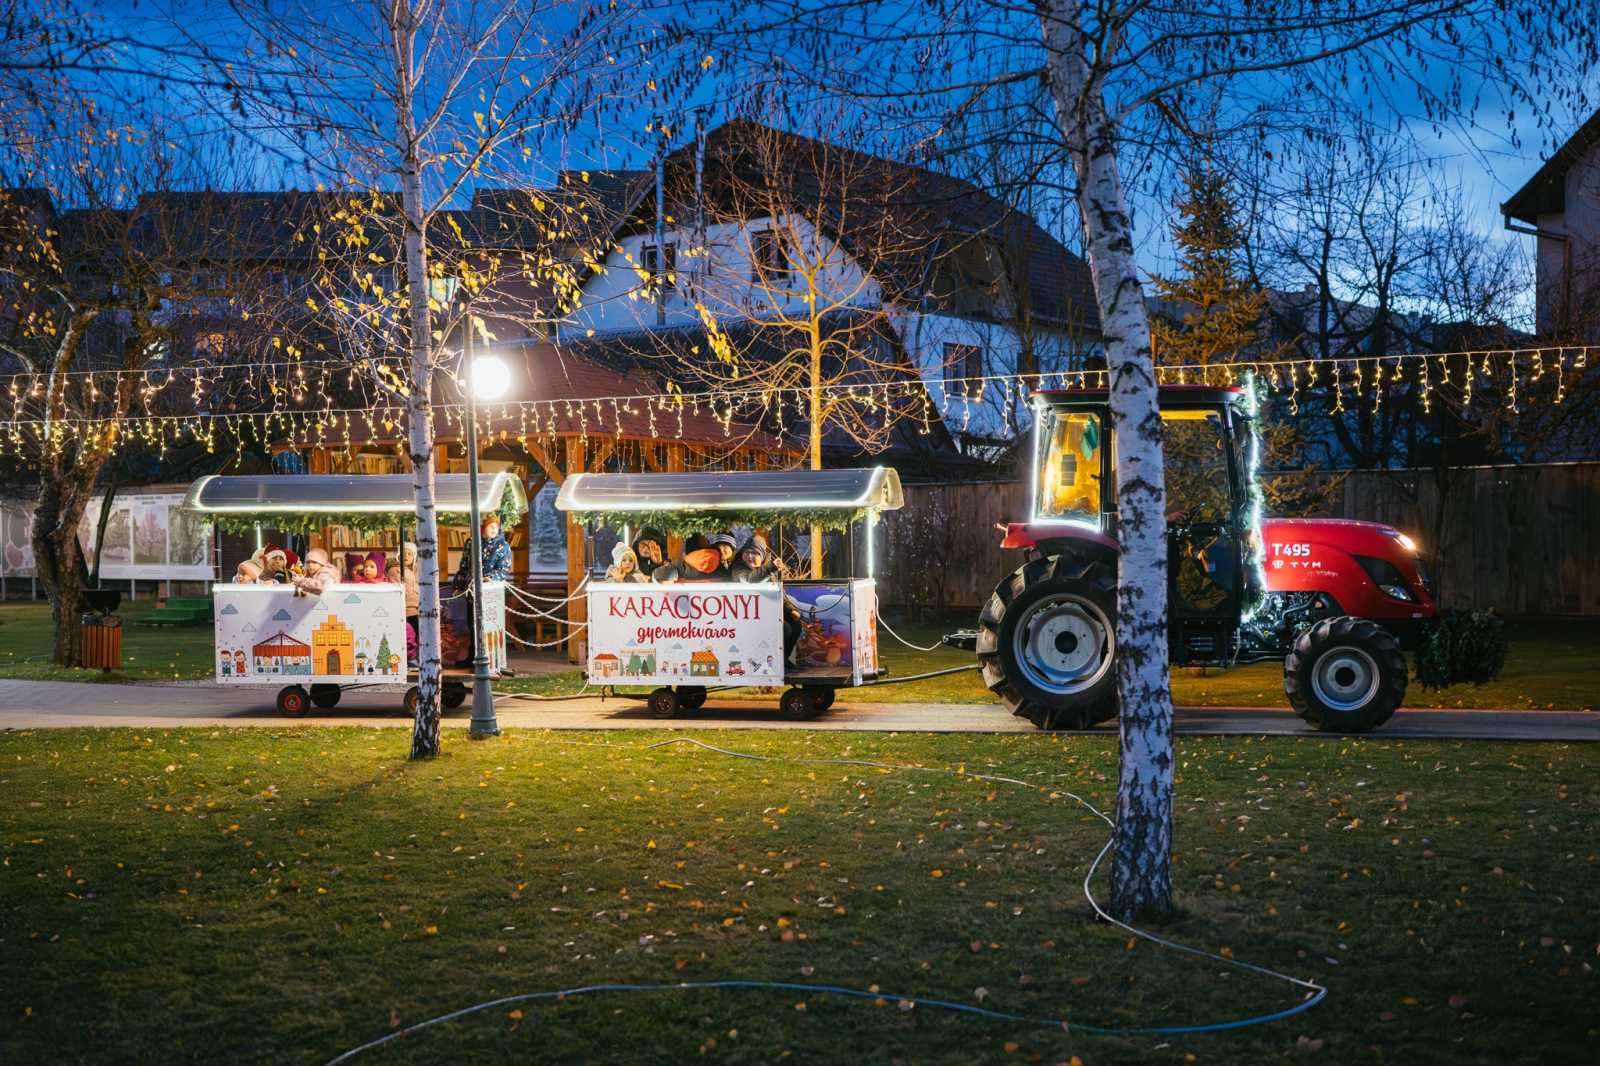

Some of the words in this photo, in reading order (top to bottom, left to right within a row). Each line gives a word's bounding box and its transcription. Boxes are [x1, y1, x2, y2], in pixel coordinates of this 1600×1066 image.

[1271, 543, 1311, 557] T495
[1290, 561, 1321, 569] TYM
[608, 592, 761, 620] KARÁCSONYI
[637, 621, 736, 644] gyermekváros
